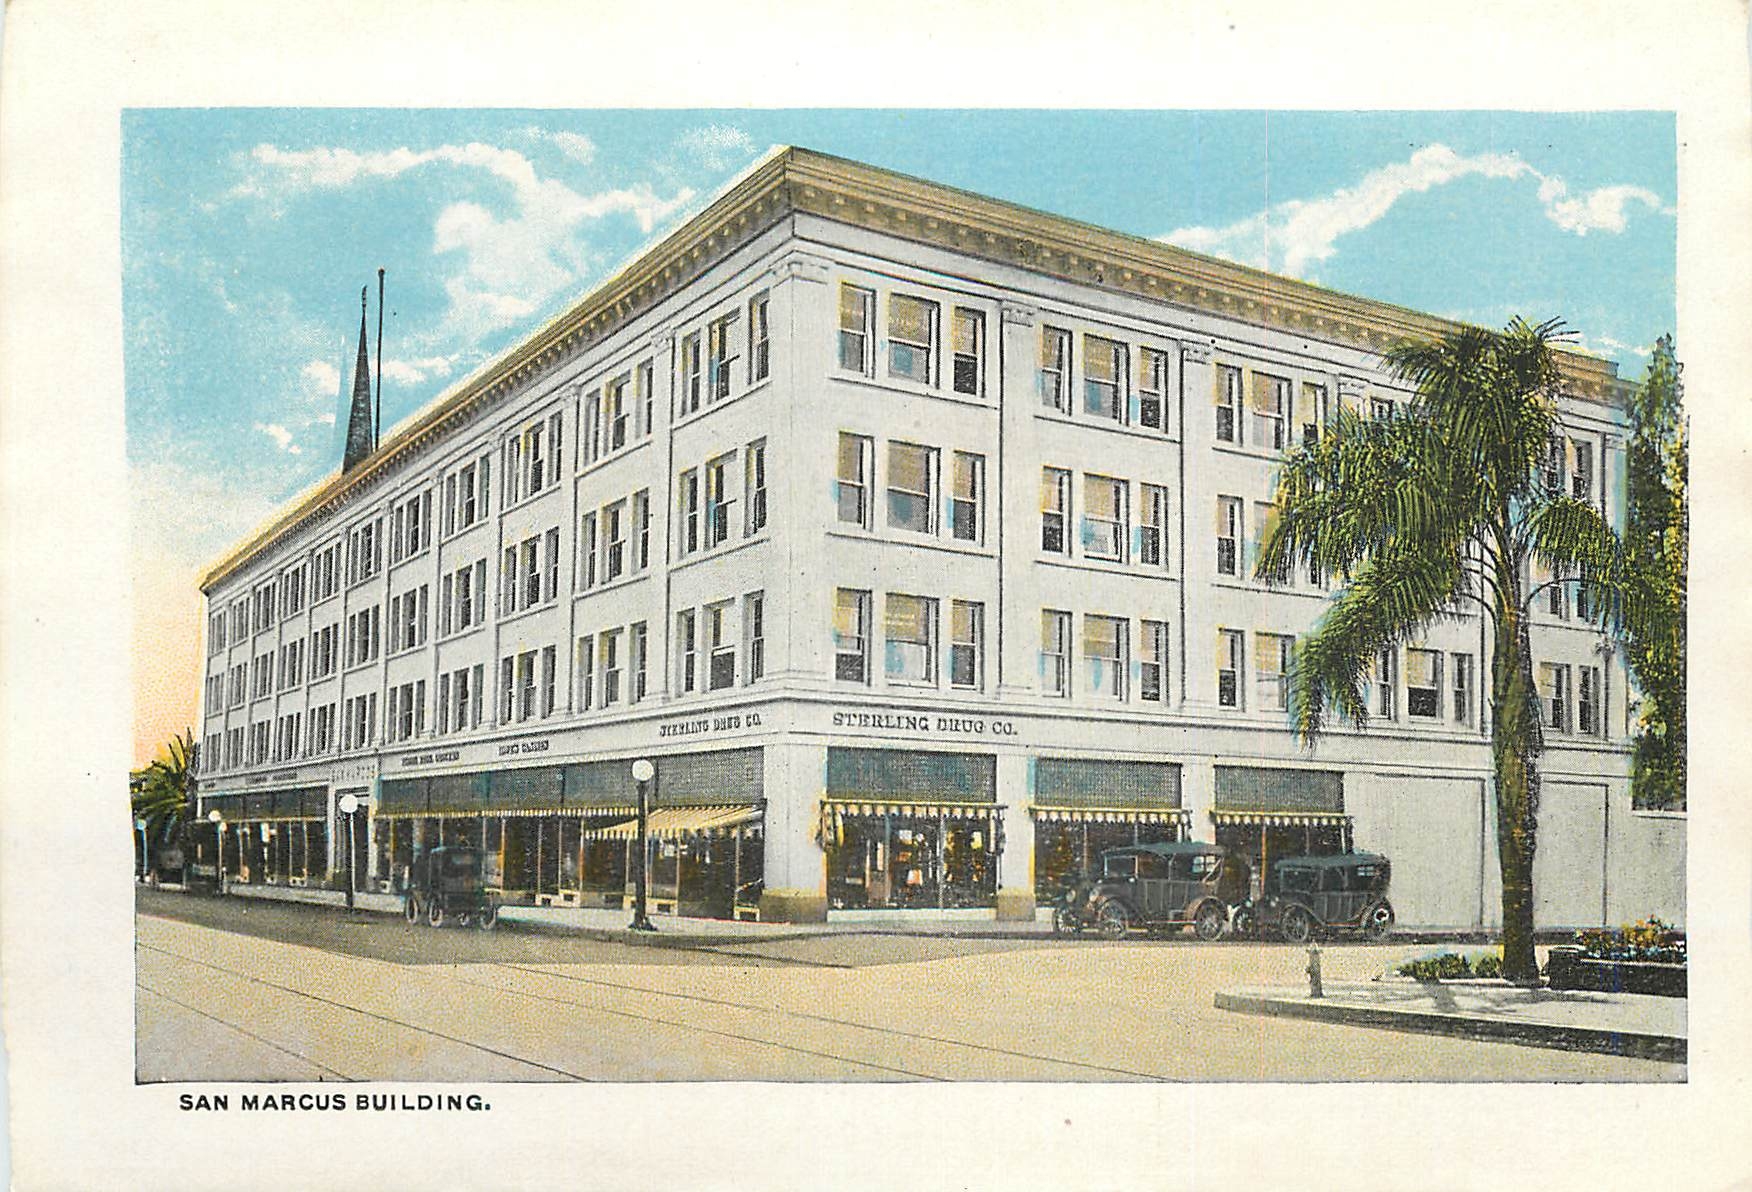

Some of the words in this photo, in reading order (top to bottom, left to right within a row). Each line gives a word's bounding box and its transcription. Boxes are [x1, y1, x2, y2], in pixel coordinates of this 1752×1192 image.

[832, 711, 930, 732] STERLING
[936, 717, 985, 734] DRUG
[991, 721, 1019, 736] CO.
